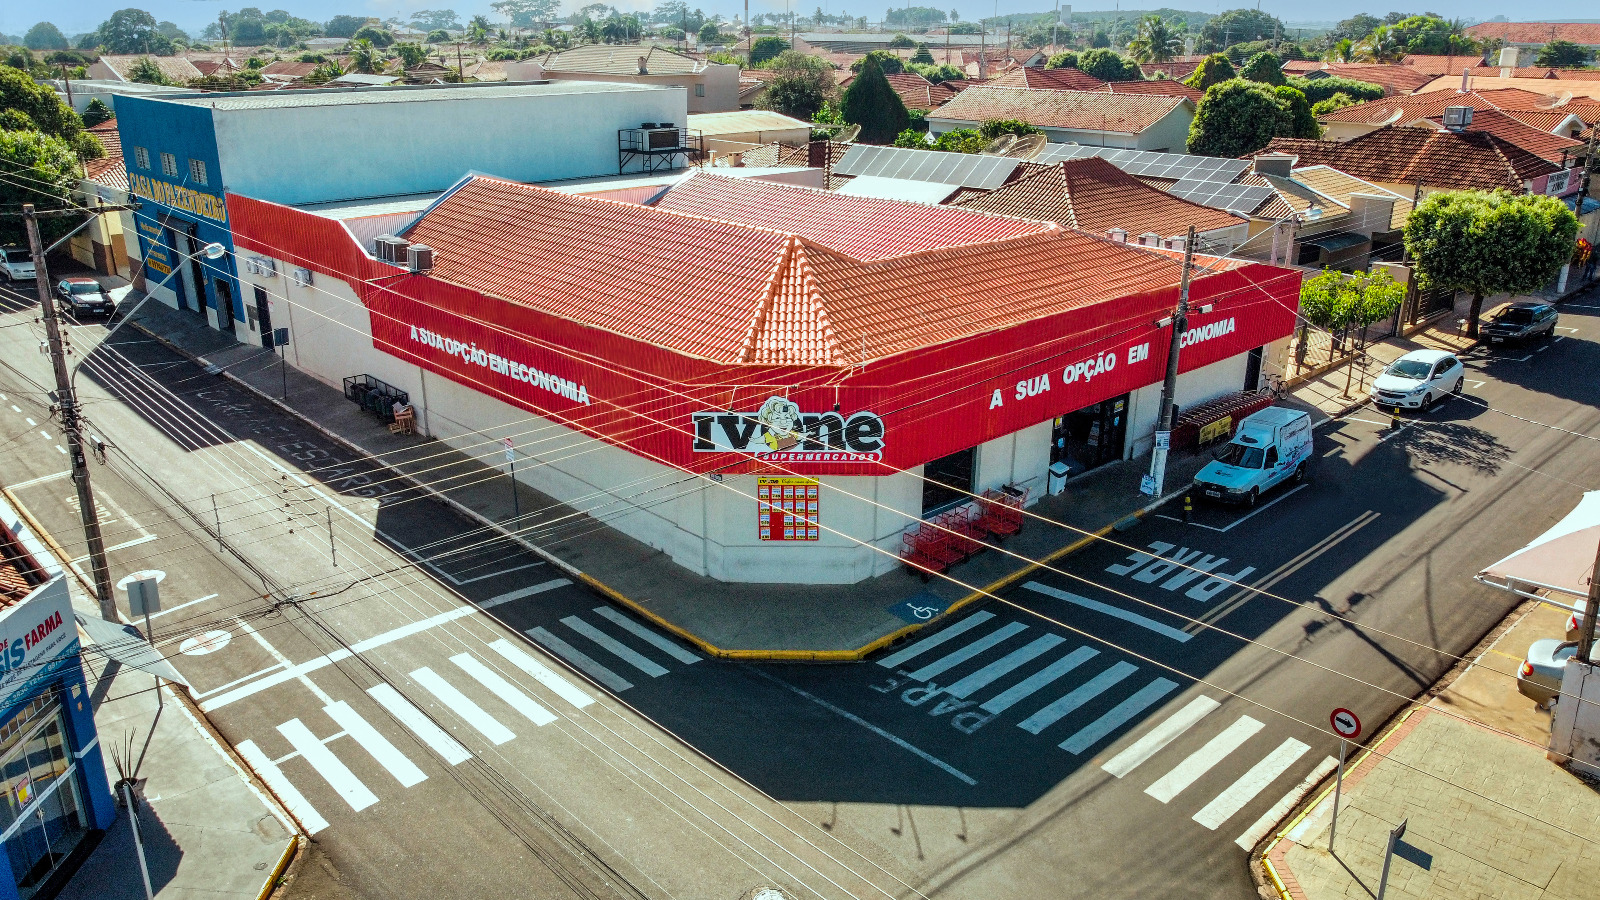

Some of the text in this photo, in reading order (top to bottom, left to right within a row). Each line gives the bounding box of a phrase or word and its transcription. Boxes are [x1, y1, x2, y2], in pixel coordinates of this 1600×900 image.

[129, 172, 226, 223] CASA DO FAZENDEIRO
[410, 324, 591, 406] A SUA OPÇÃO EM ECONOMIA
[989, 317, 1235, 410] A SUA OPÇÃO EM CONOMIA
[762, 452, 875, 462] SUPERMERCADOS
[1105, 540, 1257, 602] PARE
[25, 610, 63, 650] FARMA
